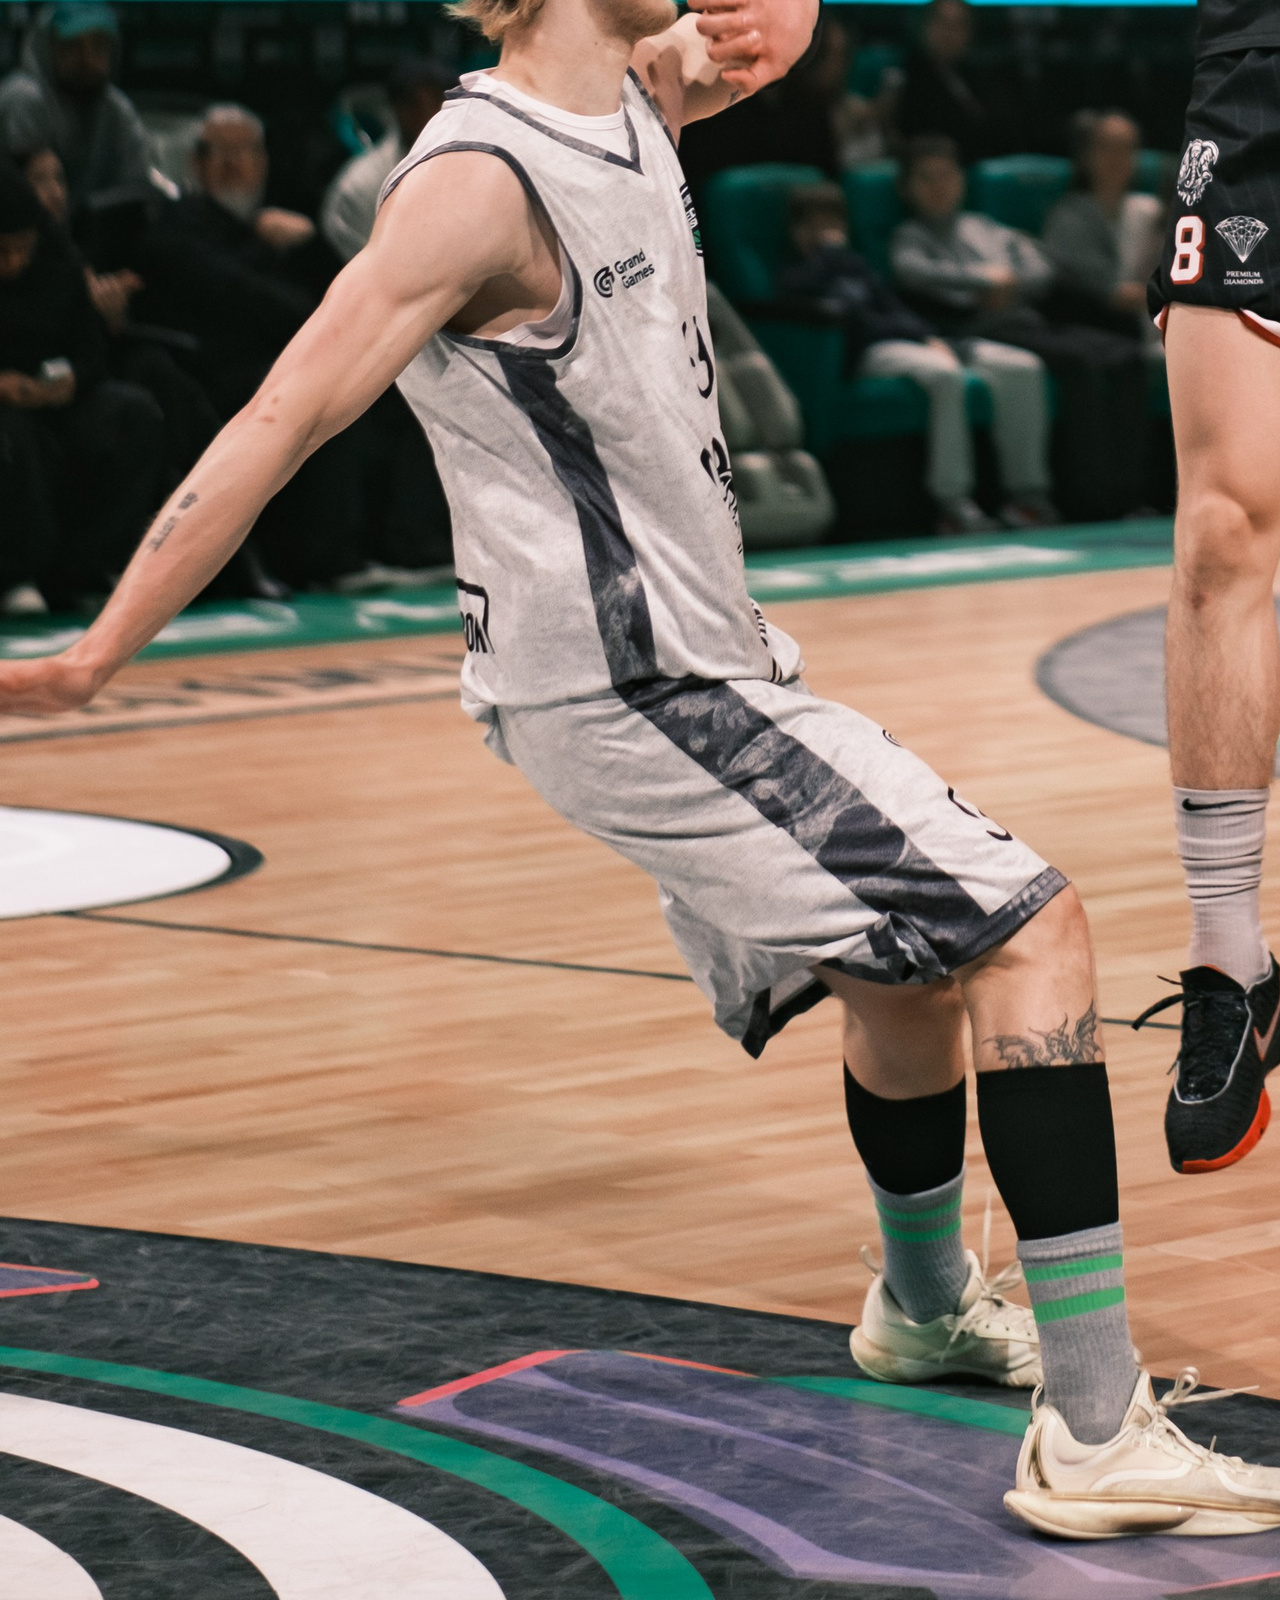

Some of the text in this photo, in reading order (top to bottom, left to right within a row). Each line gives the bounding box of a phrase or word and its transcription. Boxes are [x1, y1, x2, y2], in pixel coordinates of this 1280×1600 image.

[614, 247, 646, 275] Grand
[1169, 214, 1206, 285] 8
[621, 263, 656, 289] Games
[1223, 278, 1264, 286] DIAMONDS
[1225, 270, 1261, 278] PREMIUM
